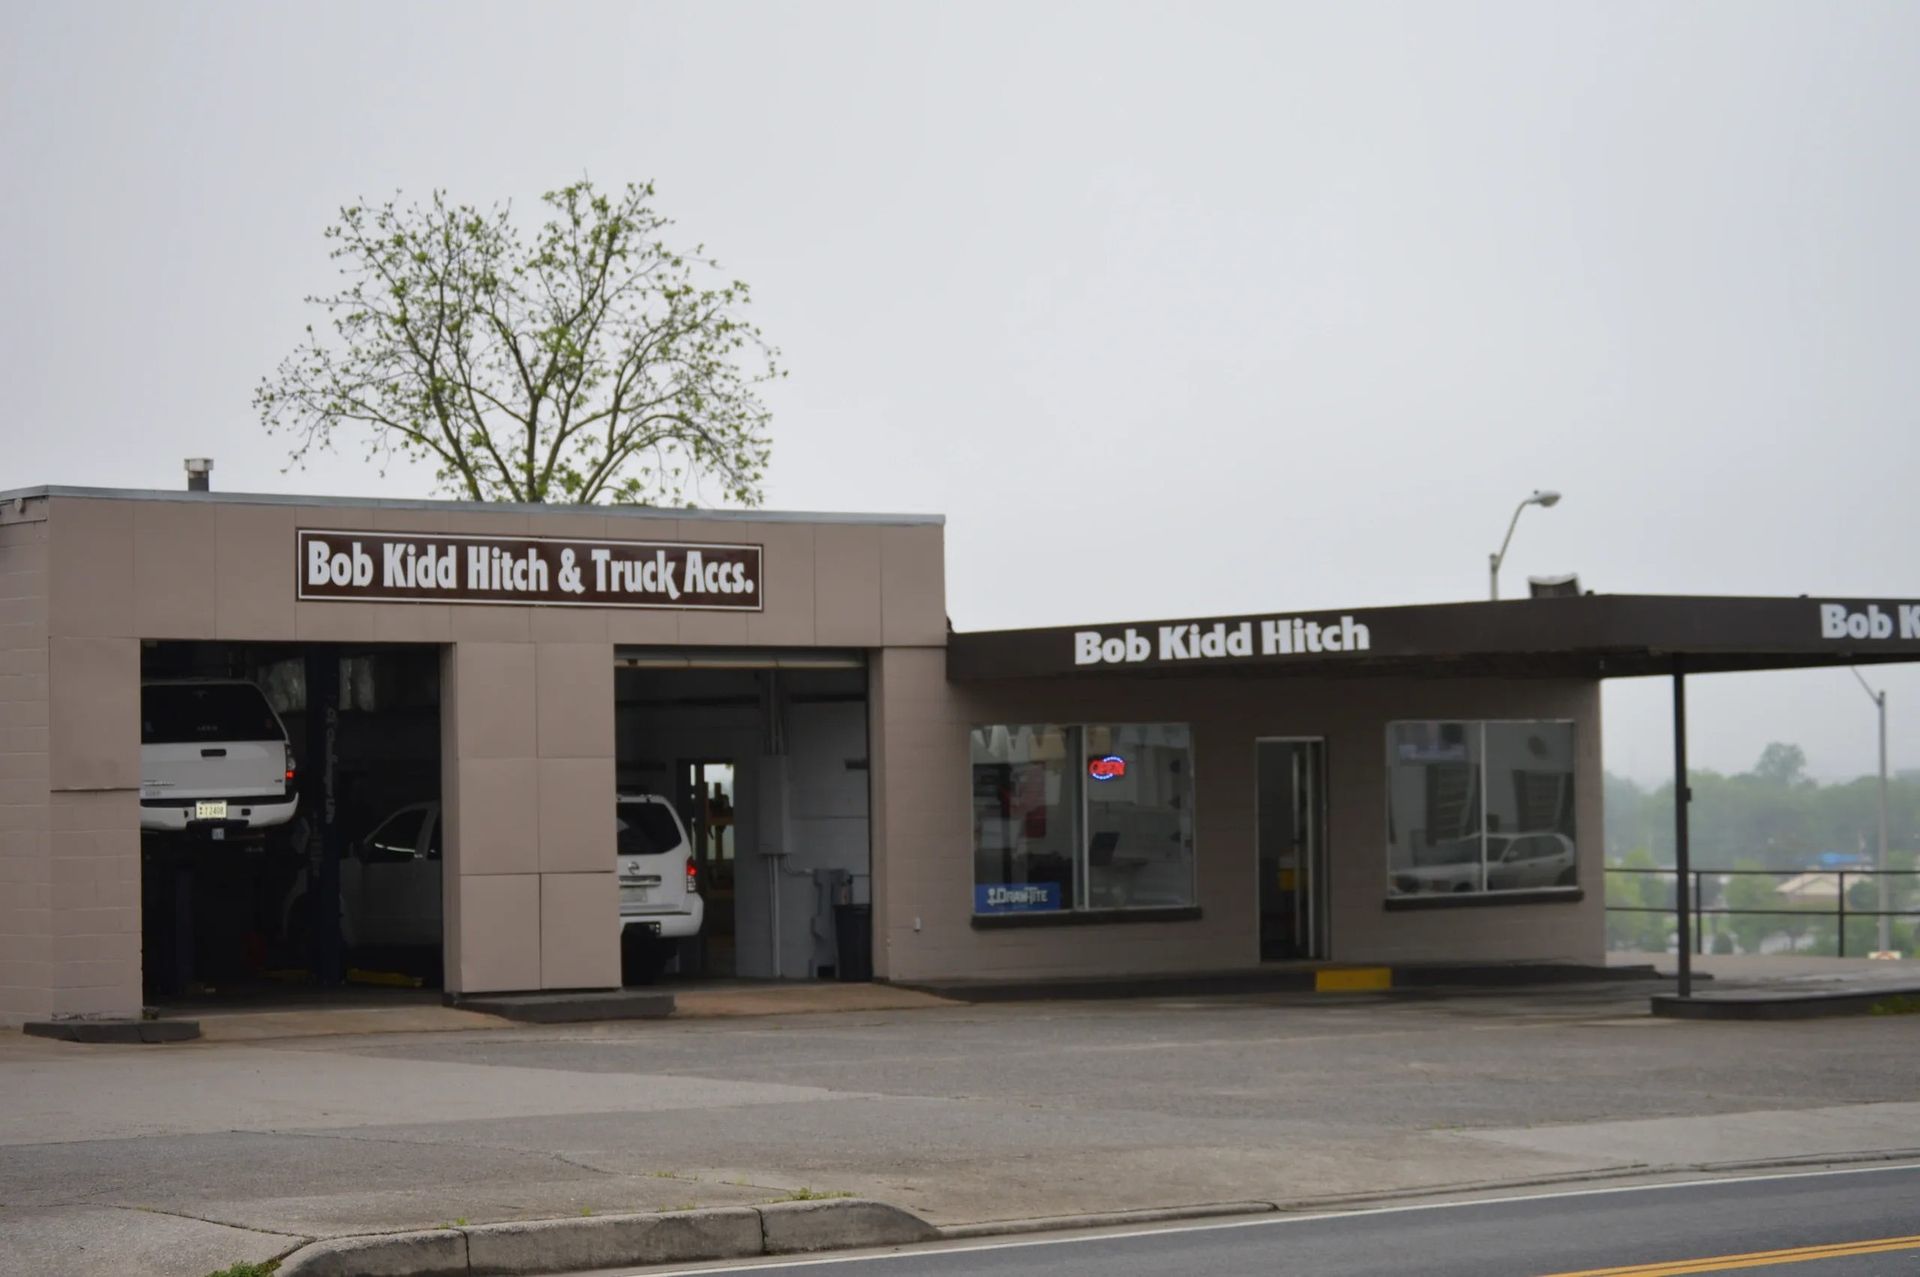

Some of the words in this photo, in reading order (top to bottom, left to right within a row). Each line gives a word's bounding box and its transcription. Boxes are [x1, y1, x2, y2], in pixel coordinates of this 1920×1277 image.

[308, 540, 374, 586] Bob
[383, 543, 457, 589] Kidd
[467, 546, 549, 592] Hitch
[558, 547, 585, 594] &
[591, 549, 681, 600] Truck
[683, 551, 754, 594] Accs.
[1074, 628, 1151, 665] Bob
[1158, 622, 1253, 660] Kidd
[1261, 615, 1370, 655] Hitch
[1821, 604, 1893, 639] Bob
